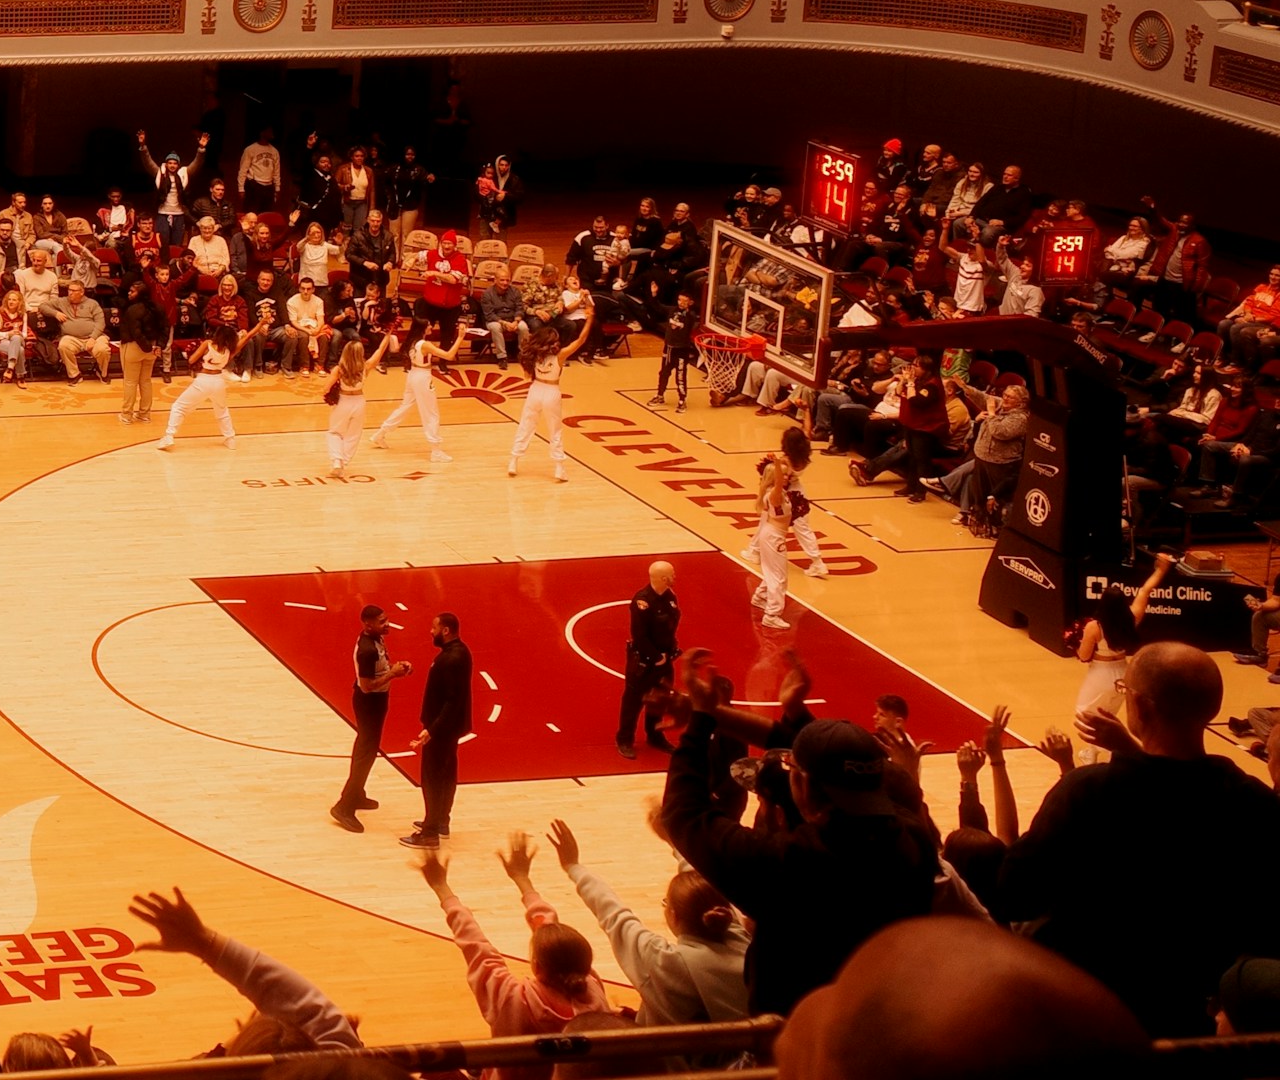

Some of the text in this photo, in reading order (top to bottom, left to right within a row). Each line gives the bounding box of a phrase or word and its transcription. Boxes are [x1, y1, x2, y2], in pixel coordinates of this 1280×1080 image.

[822, 155, 854, 184] 2:59
[825, 182, 848, 221] 14
[1053, 236, 1083, 252] 2:59
[1057, 256, 1075, 272] 14
[1073, 334, 1108, 365] SPALDING
[241, 474, 377, 489] CLIFFS
[1009, 559, 1044, 584] SERVPRO
[1176, 586, 1213, 602] Clinic
[553, 1038, 574, 1051] 13
